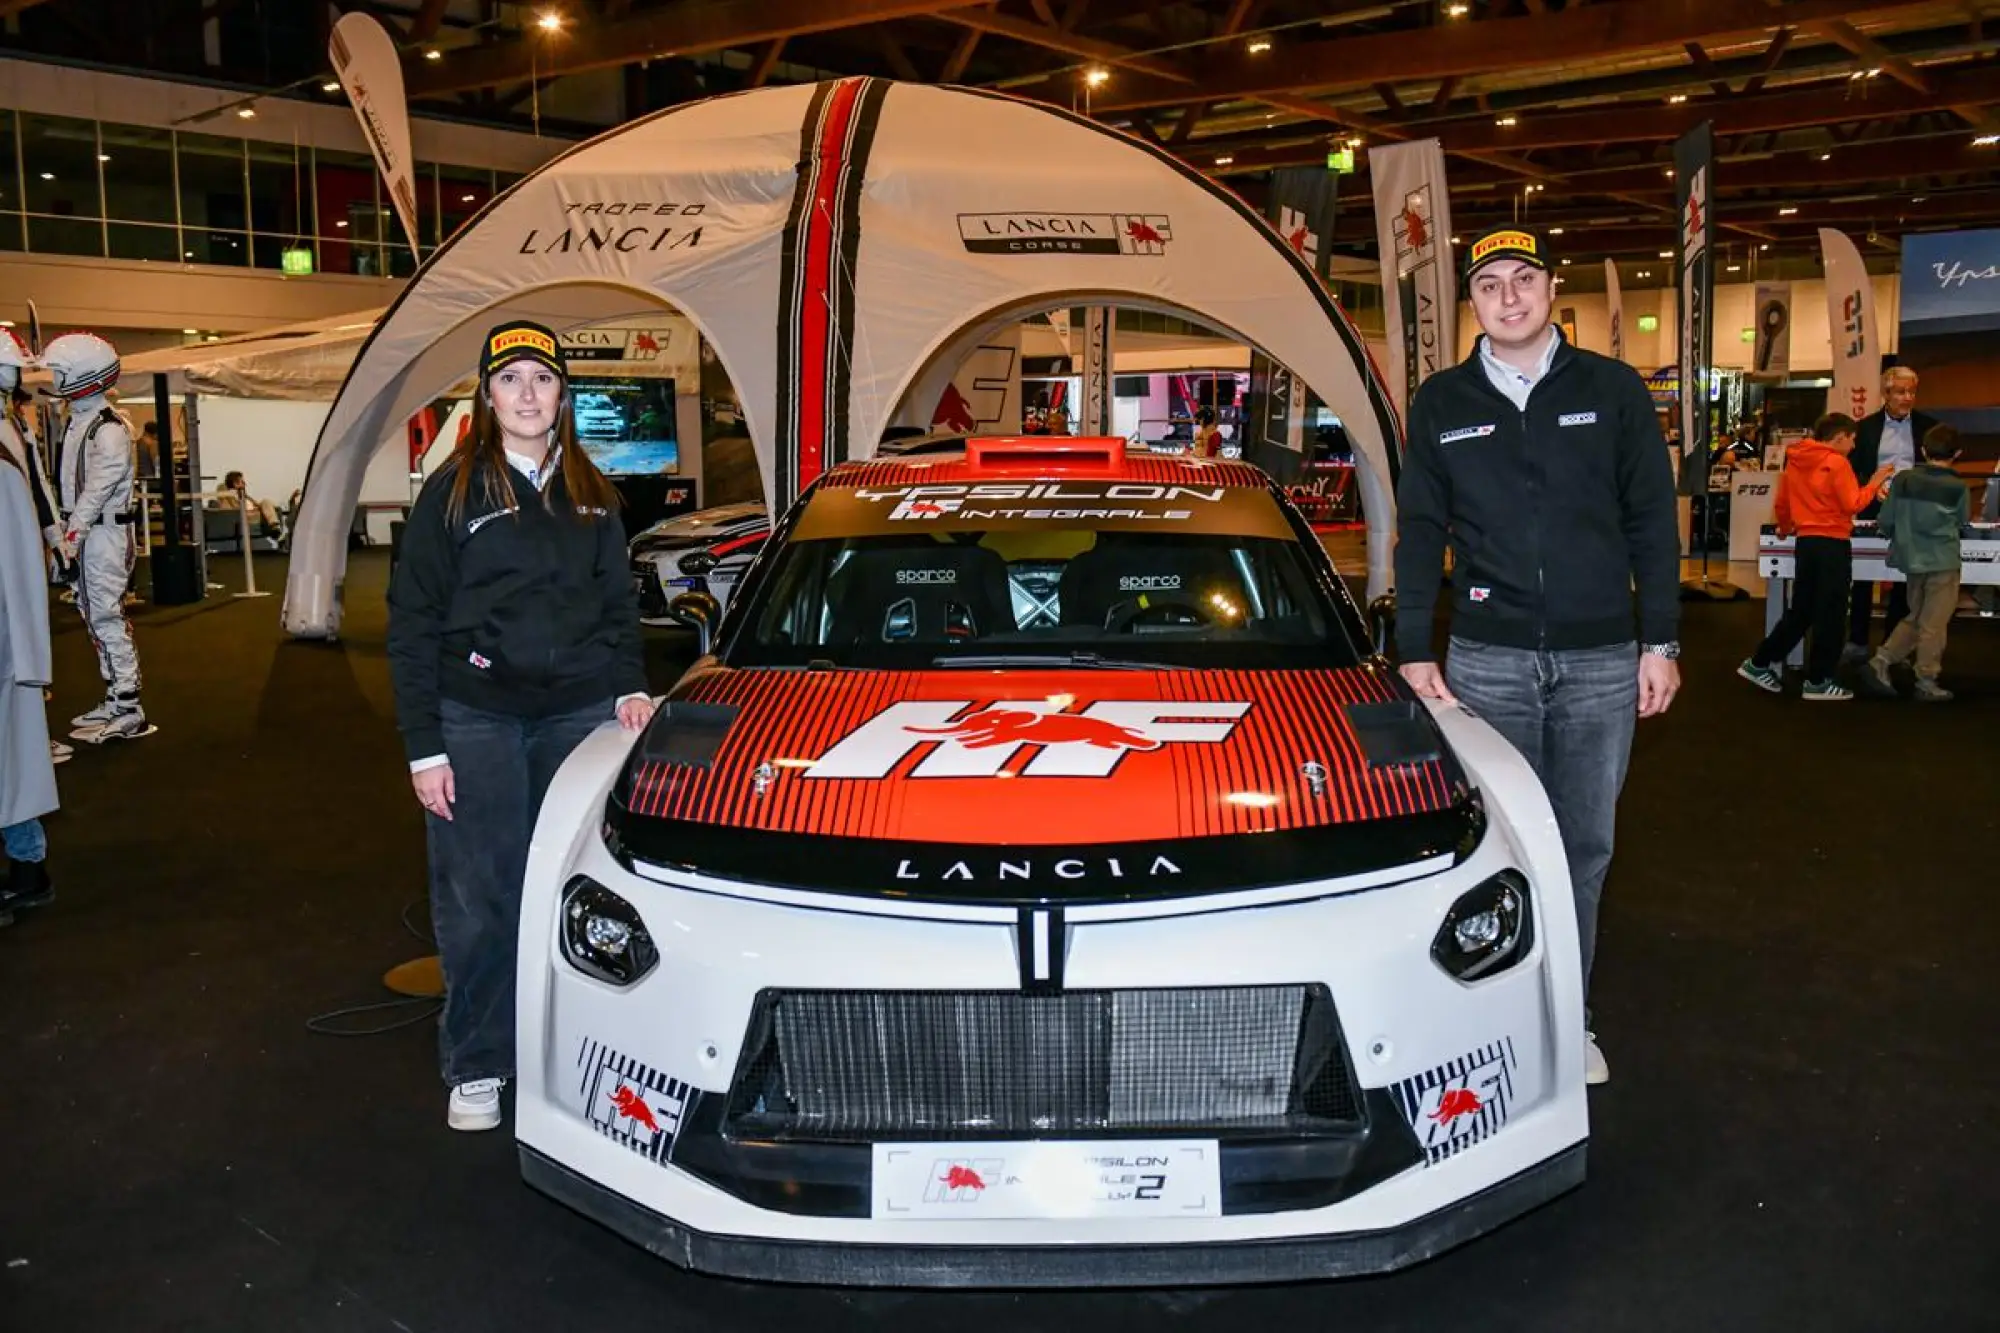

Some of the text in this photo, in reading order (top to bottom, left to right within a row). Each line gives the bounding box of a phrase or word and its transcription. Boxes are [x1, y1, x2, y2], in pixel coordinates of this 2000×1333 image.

[565, 202, 706, 216] TROFEO
[983, 219, 1096, 235] LANCIA
[519, 226, 704, 254] LANCIA
[1009, 242, 1082, 250] CORSE
[558, 332, 611, 345] NCIA
[855, 484, 1225, 502] YPSILON
[960, 510, 1192, 519] INTEGRALE
[896, 569, 956, 583] sparco
[1120, 575, 1181, 590] sparco
[896, 855, 1182, 880] LANCIA
[1135, 1175, 1166, 1200] 2
